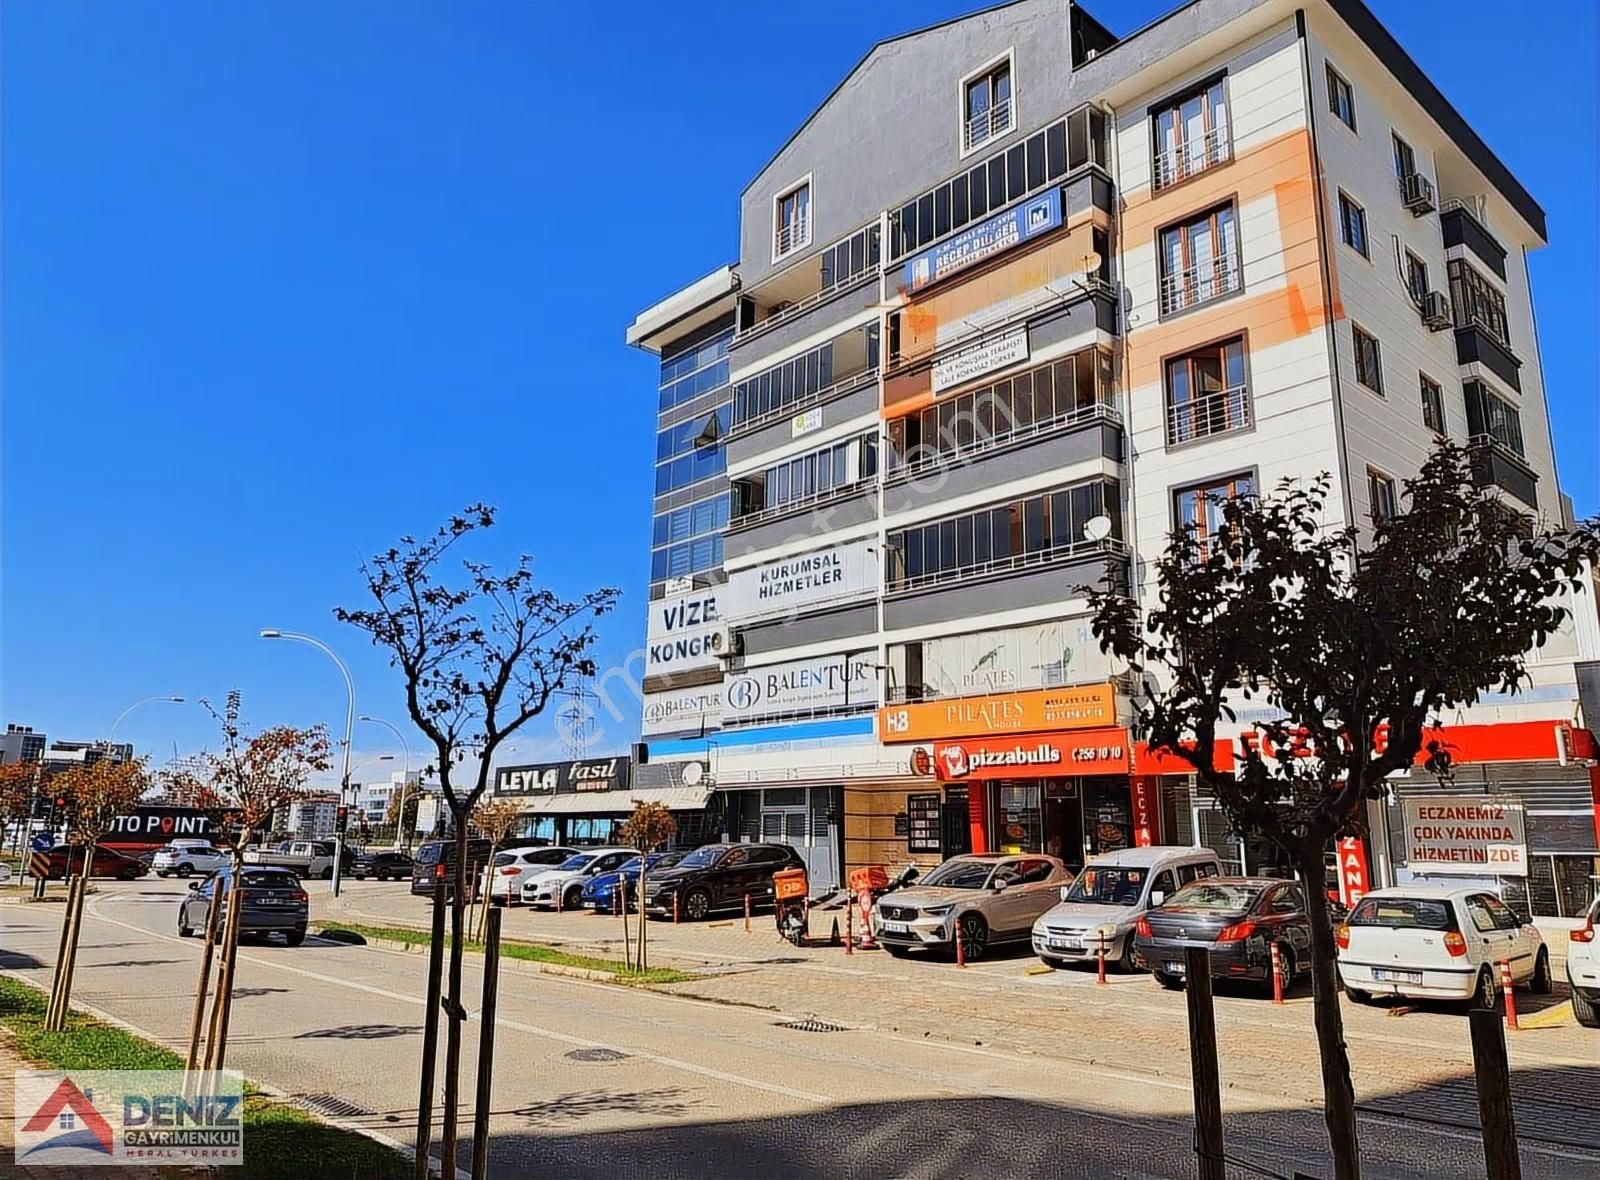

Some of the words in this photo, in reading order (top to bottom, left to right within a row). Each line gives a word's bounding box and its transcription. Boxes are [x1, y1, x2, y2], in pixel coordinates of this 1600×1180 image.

[936, 243, 970, 269] RECEP
[761, 553, 840, 583] KURUMSAL
[760, 568, 842, 599] HİZMETLER
[664, 597, 716, 631] VİZE
[767, 661, 868, 698] BALENTUR
[946, 699, 1025, 729] PILATES
[969, 743, 1062, 771] pizzabulls
[1098, 746, 1109, 760] 10
[1111, 745, 1122, 759] 10
[500, 768, 558, 791] LEYLA
[1137, 782, 1152, 848] ECZA
[1413, 826, 1443, 842] ÇOK
[1446, 826, 1514, 840] YAKINDA
